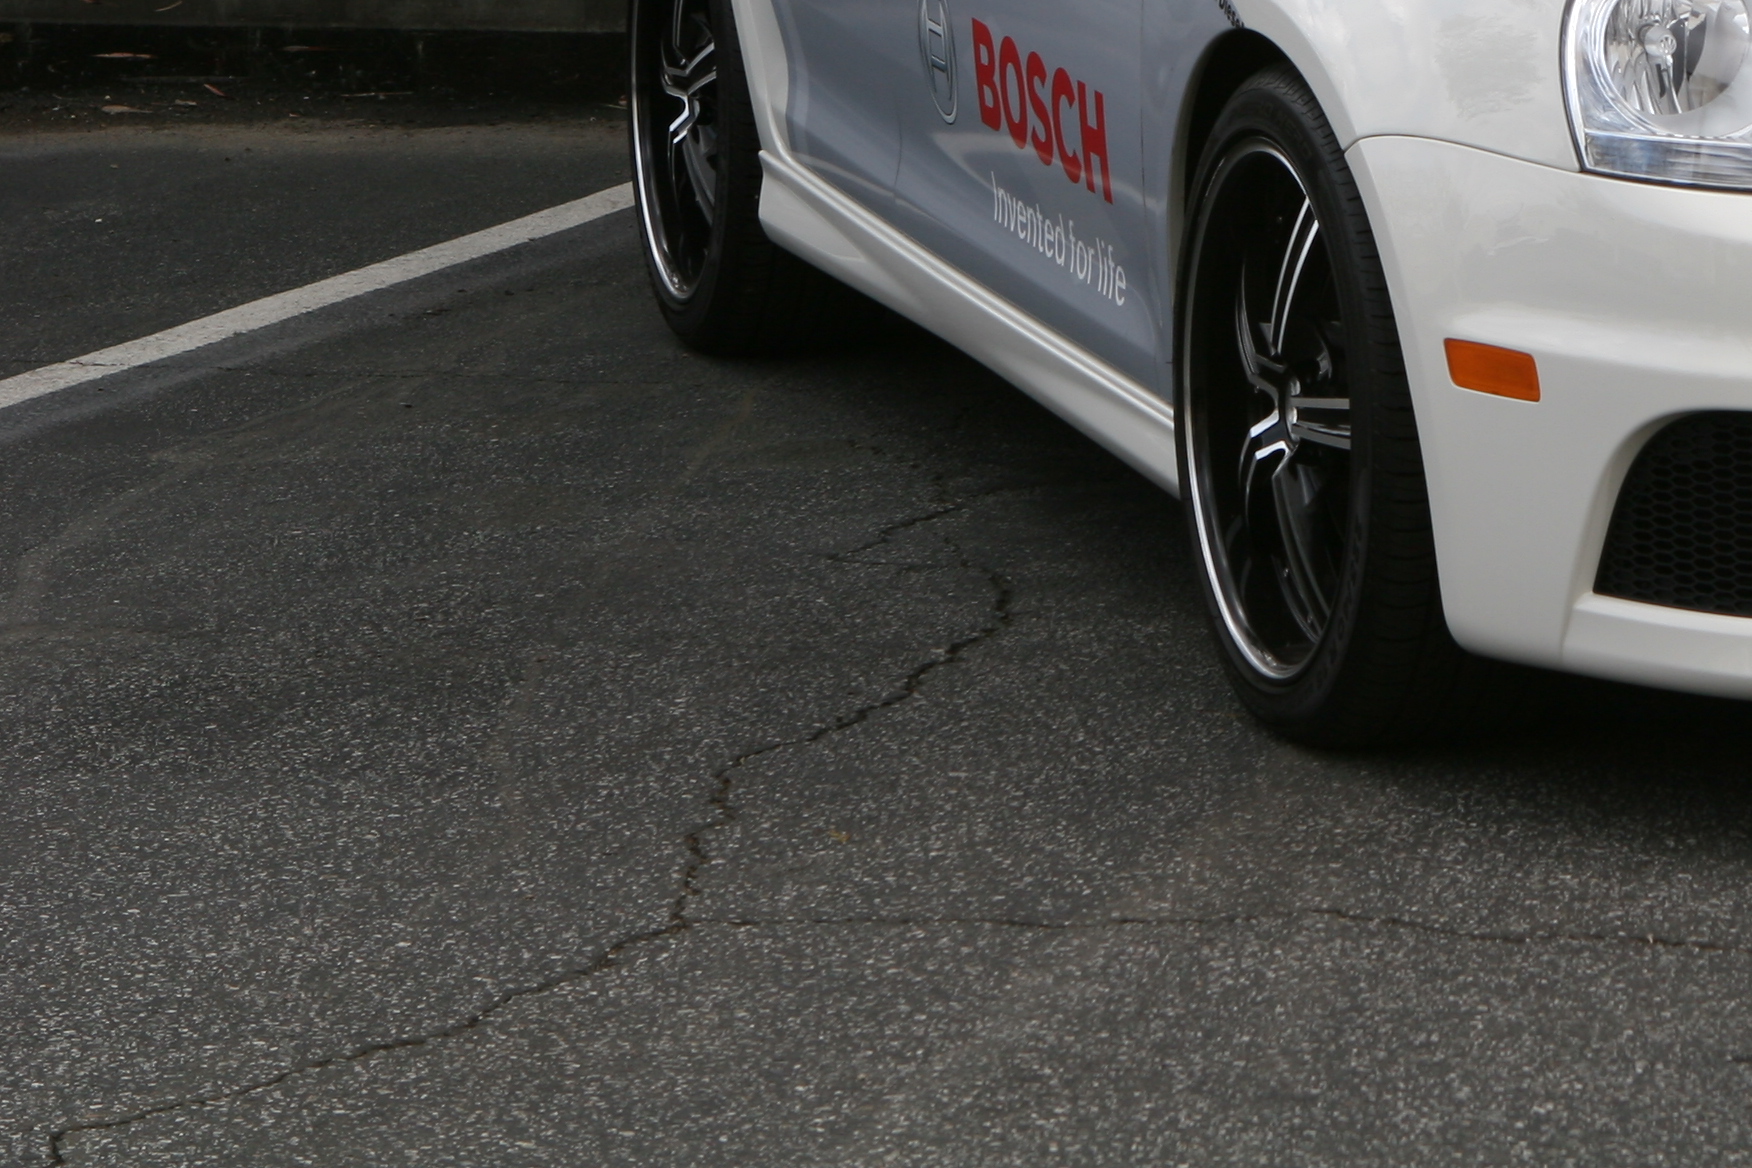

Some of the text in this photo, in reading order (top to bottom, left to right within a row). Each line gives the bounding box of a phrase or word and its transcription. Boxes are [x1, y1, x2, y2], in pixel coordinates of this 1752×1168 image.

[971, 17, 1114, 205] BOSCH
[991, 170, 1127, 306] Invented for life
